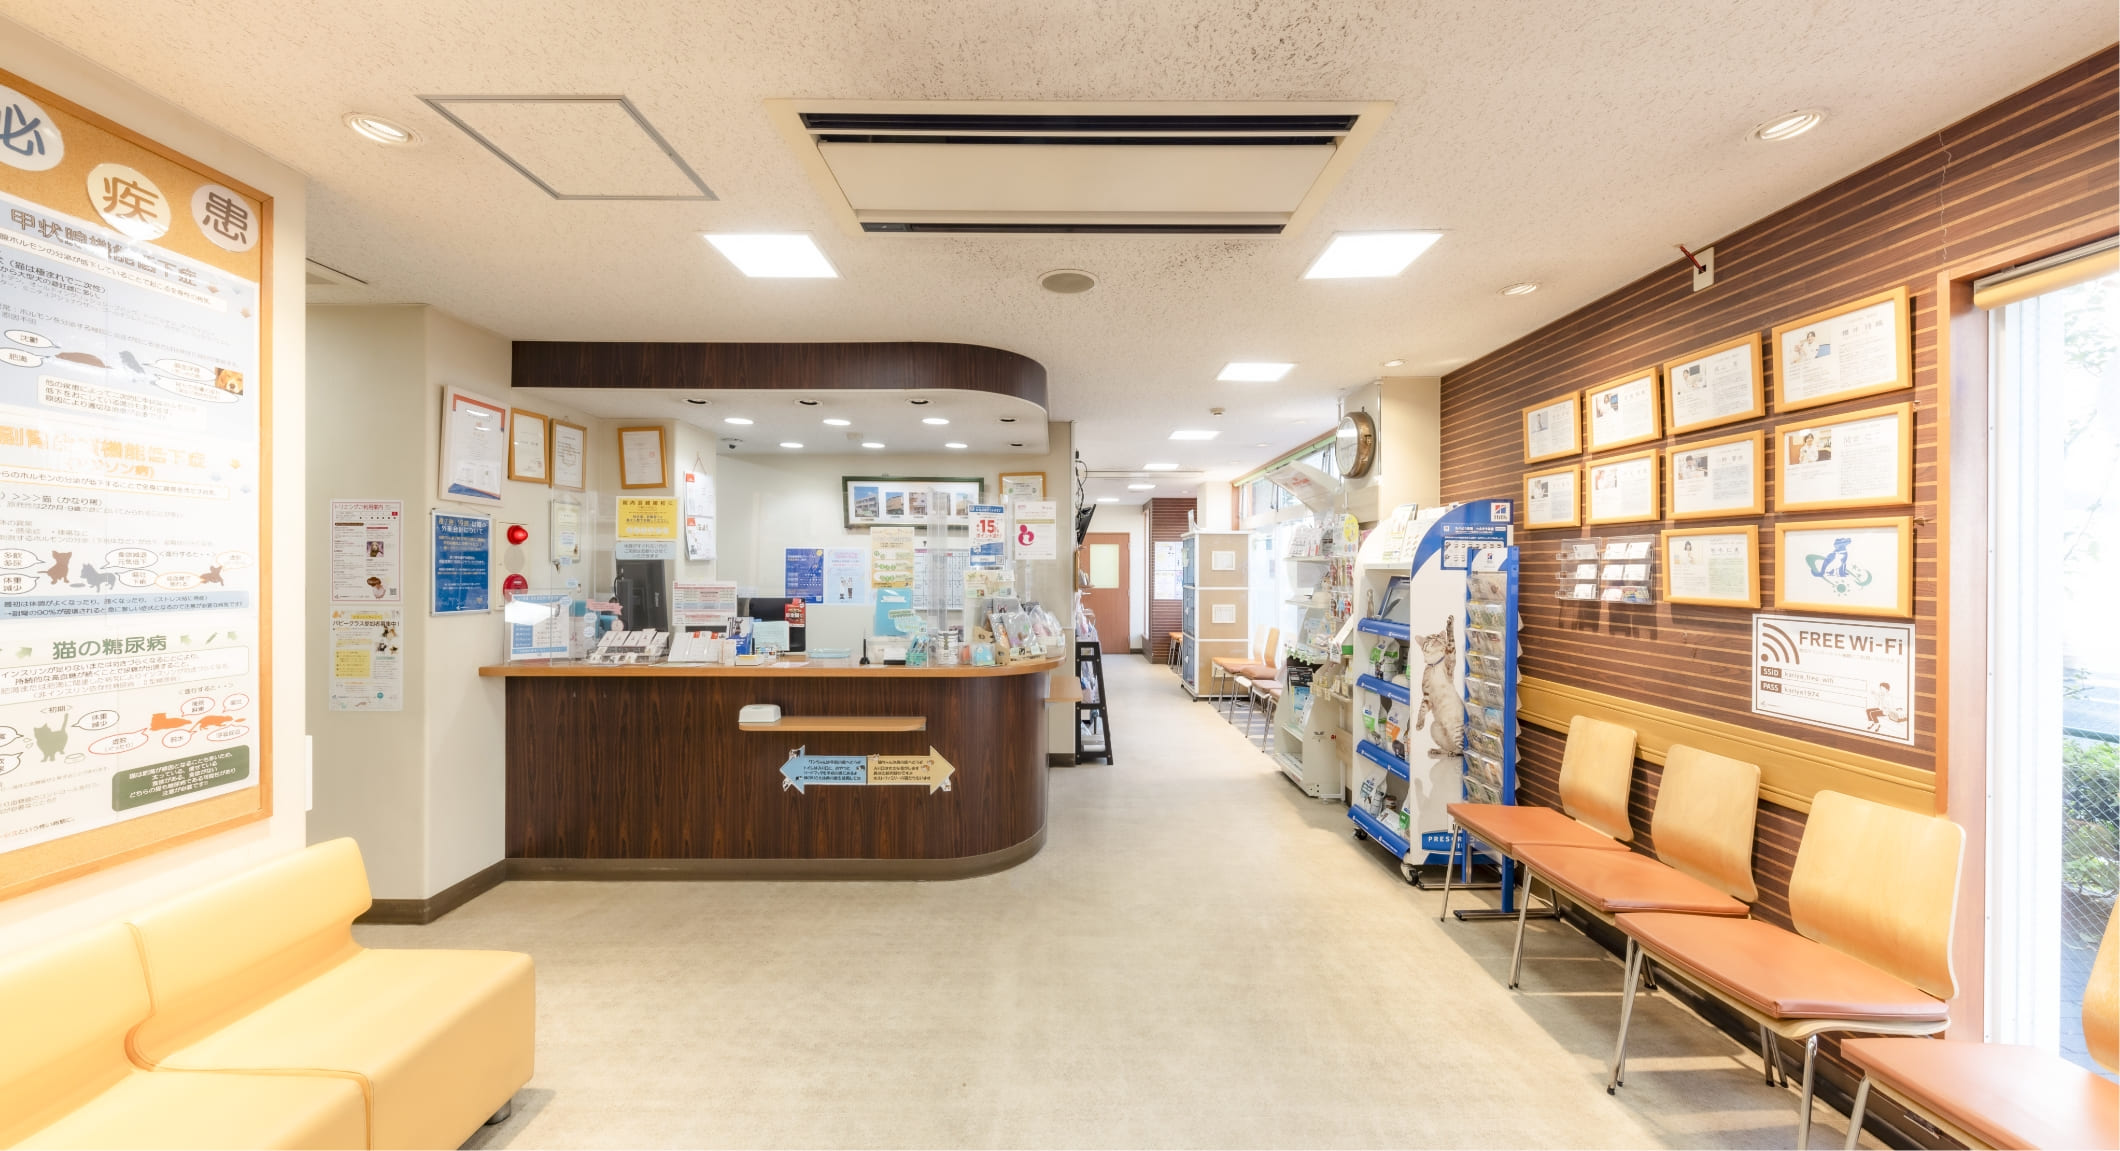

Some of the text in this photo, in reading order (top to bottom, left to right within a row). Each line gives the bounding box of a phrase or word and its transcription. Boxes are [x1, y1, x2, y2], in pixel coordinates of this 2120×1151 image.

[102, 176, 160, 223] 疾
[202, 191, 249, 245] 患
[52, 635, 168, 660] 猫の糖尿病
[1799, 630, 1904, 656] FREE Wi-Fi
[1763, 667, 1779, 677] SSID
[1762, 682, 1779, 692] PASS
